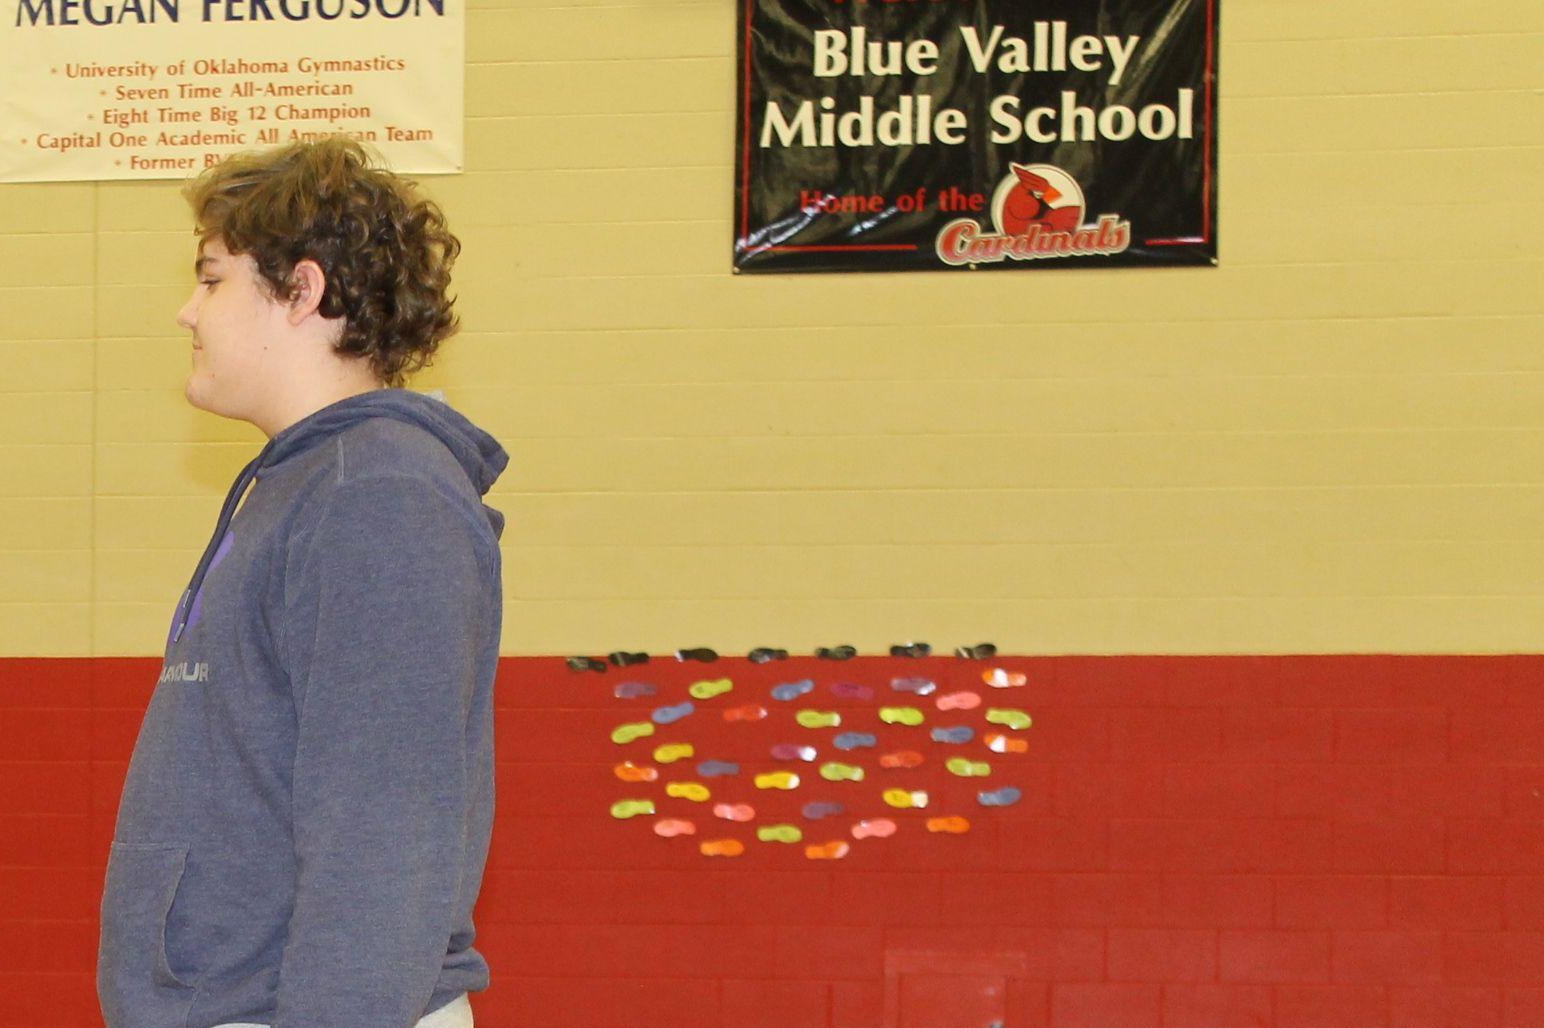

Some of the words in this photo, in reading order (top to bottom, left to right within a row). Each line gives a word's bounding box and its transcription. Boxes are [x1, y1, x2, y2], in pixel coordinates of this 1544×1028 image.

[16, 0, 179, 26] MEGAN
[202, 0, 445, 22] FERGUSON
[812, 26, 939, 77] Blue
[959, 21, 1140, 85] Valley
[65, 62, 158, 81] University
[167, 60, 185, 76] of
[194, 59, 288, 76] Oklahoma
[298, 55, 405, 77] Gymnastics
[115, 85, 169, 100] Seven
[177, 83, 222, 99] Time
[230, 80, 353, 97] All-American
[103, 108, 149, 128] Eight
[158, 107, 202, 123] Time
[210, 106, 238, 126] Big
[249, 106, 266, 120] 12
[275, 103, 371, 123] Champion
[760, 95, 967, 148] Middle
[989, 88, 1194, 145] School
[36, 131, 101, 152] Capital
[109, 132, 148, 147] One
[156, 129, 246, 147] Academic
[255, 128, 278, 144] All
[385, 126, 433, 142] Team
[130, 155, 195, 170] Former
[800, 190, 884, 213] Home
[896, 187, 926, 212] of
[939, 186, 985, 211] the
[936, 214, 1130, 266] Cardinals
